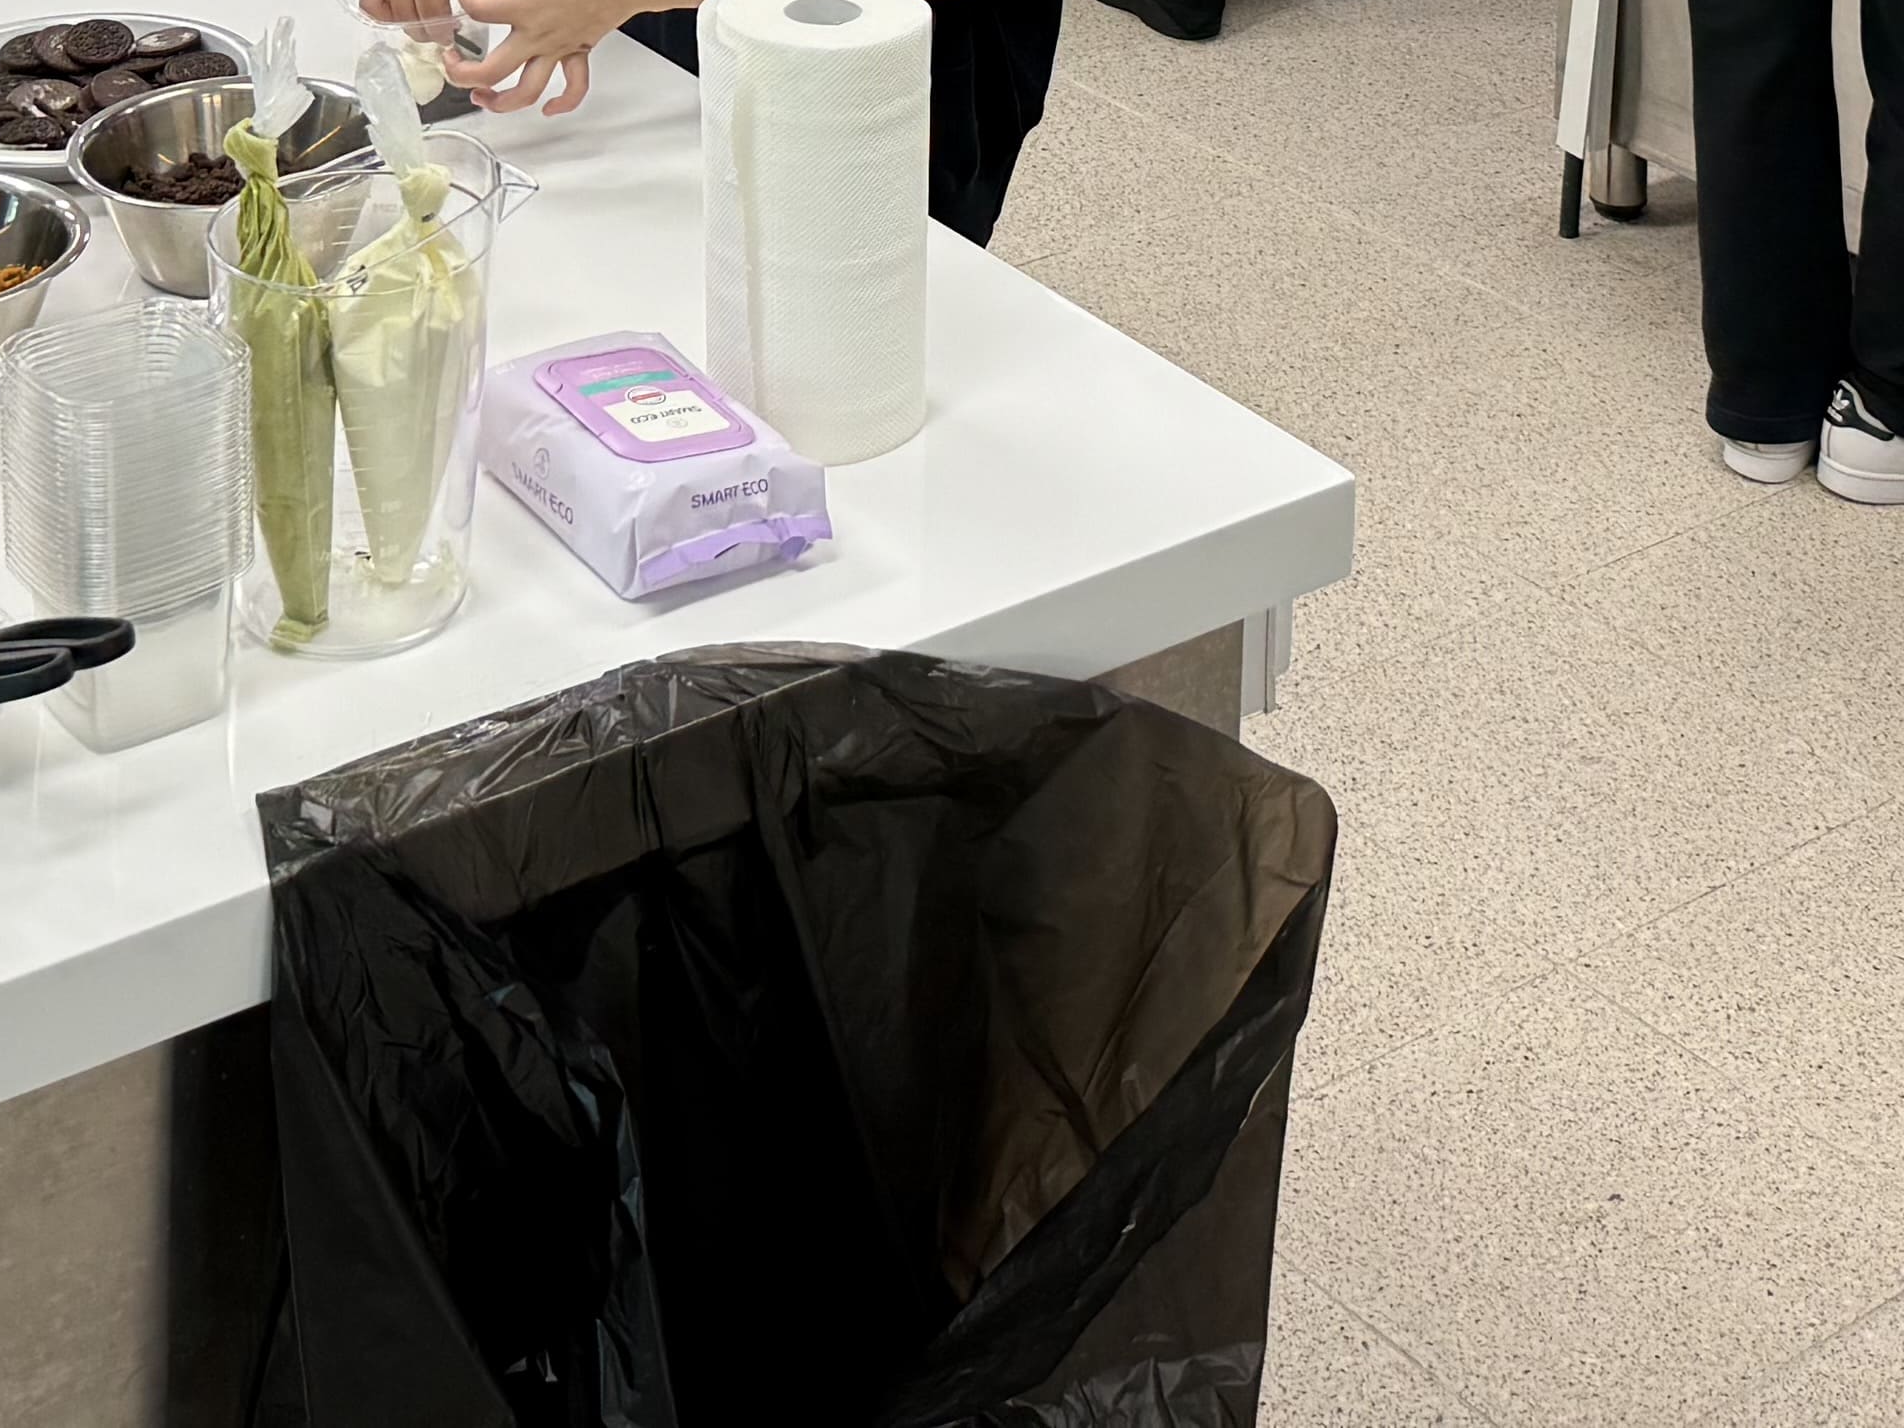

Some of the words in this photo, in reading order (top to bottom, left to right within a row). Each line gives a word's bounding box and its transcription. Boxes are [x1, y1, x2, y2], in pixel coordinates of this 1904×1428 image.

[691, 485, 740, 509] SMART
[742, 479, 769, 498] ECO
[549, 494, 574, 525] ECO
